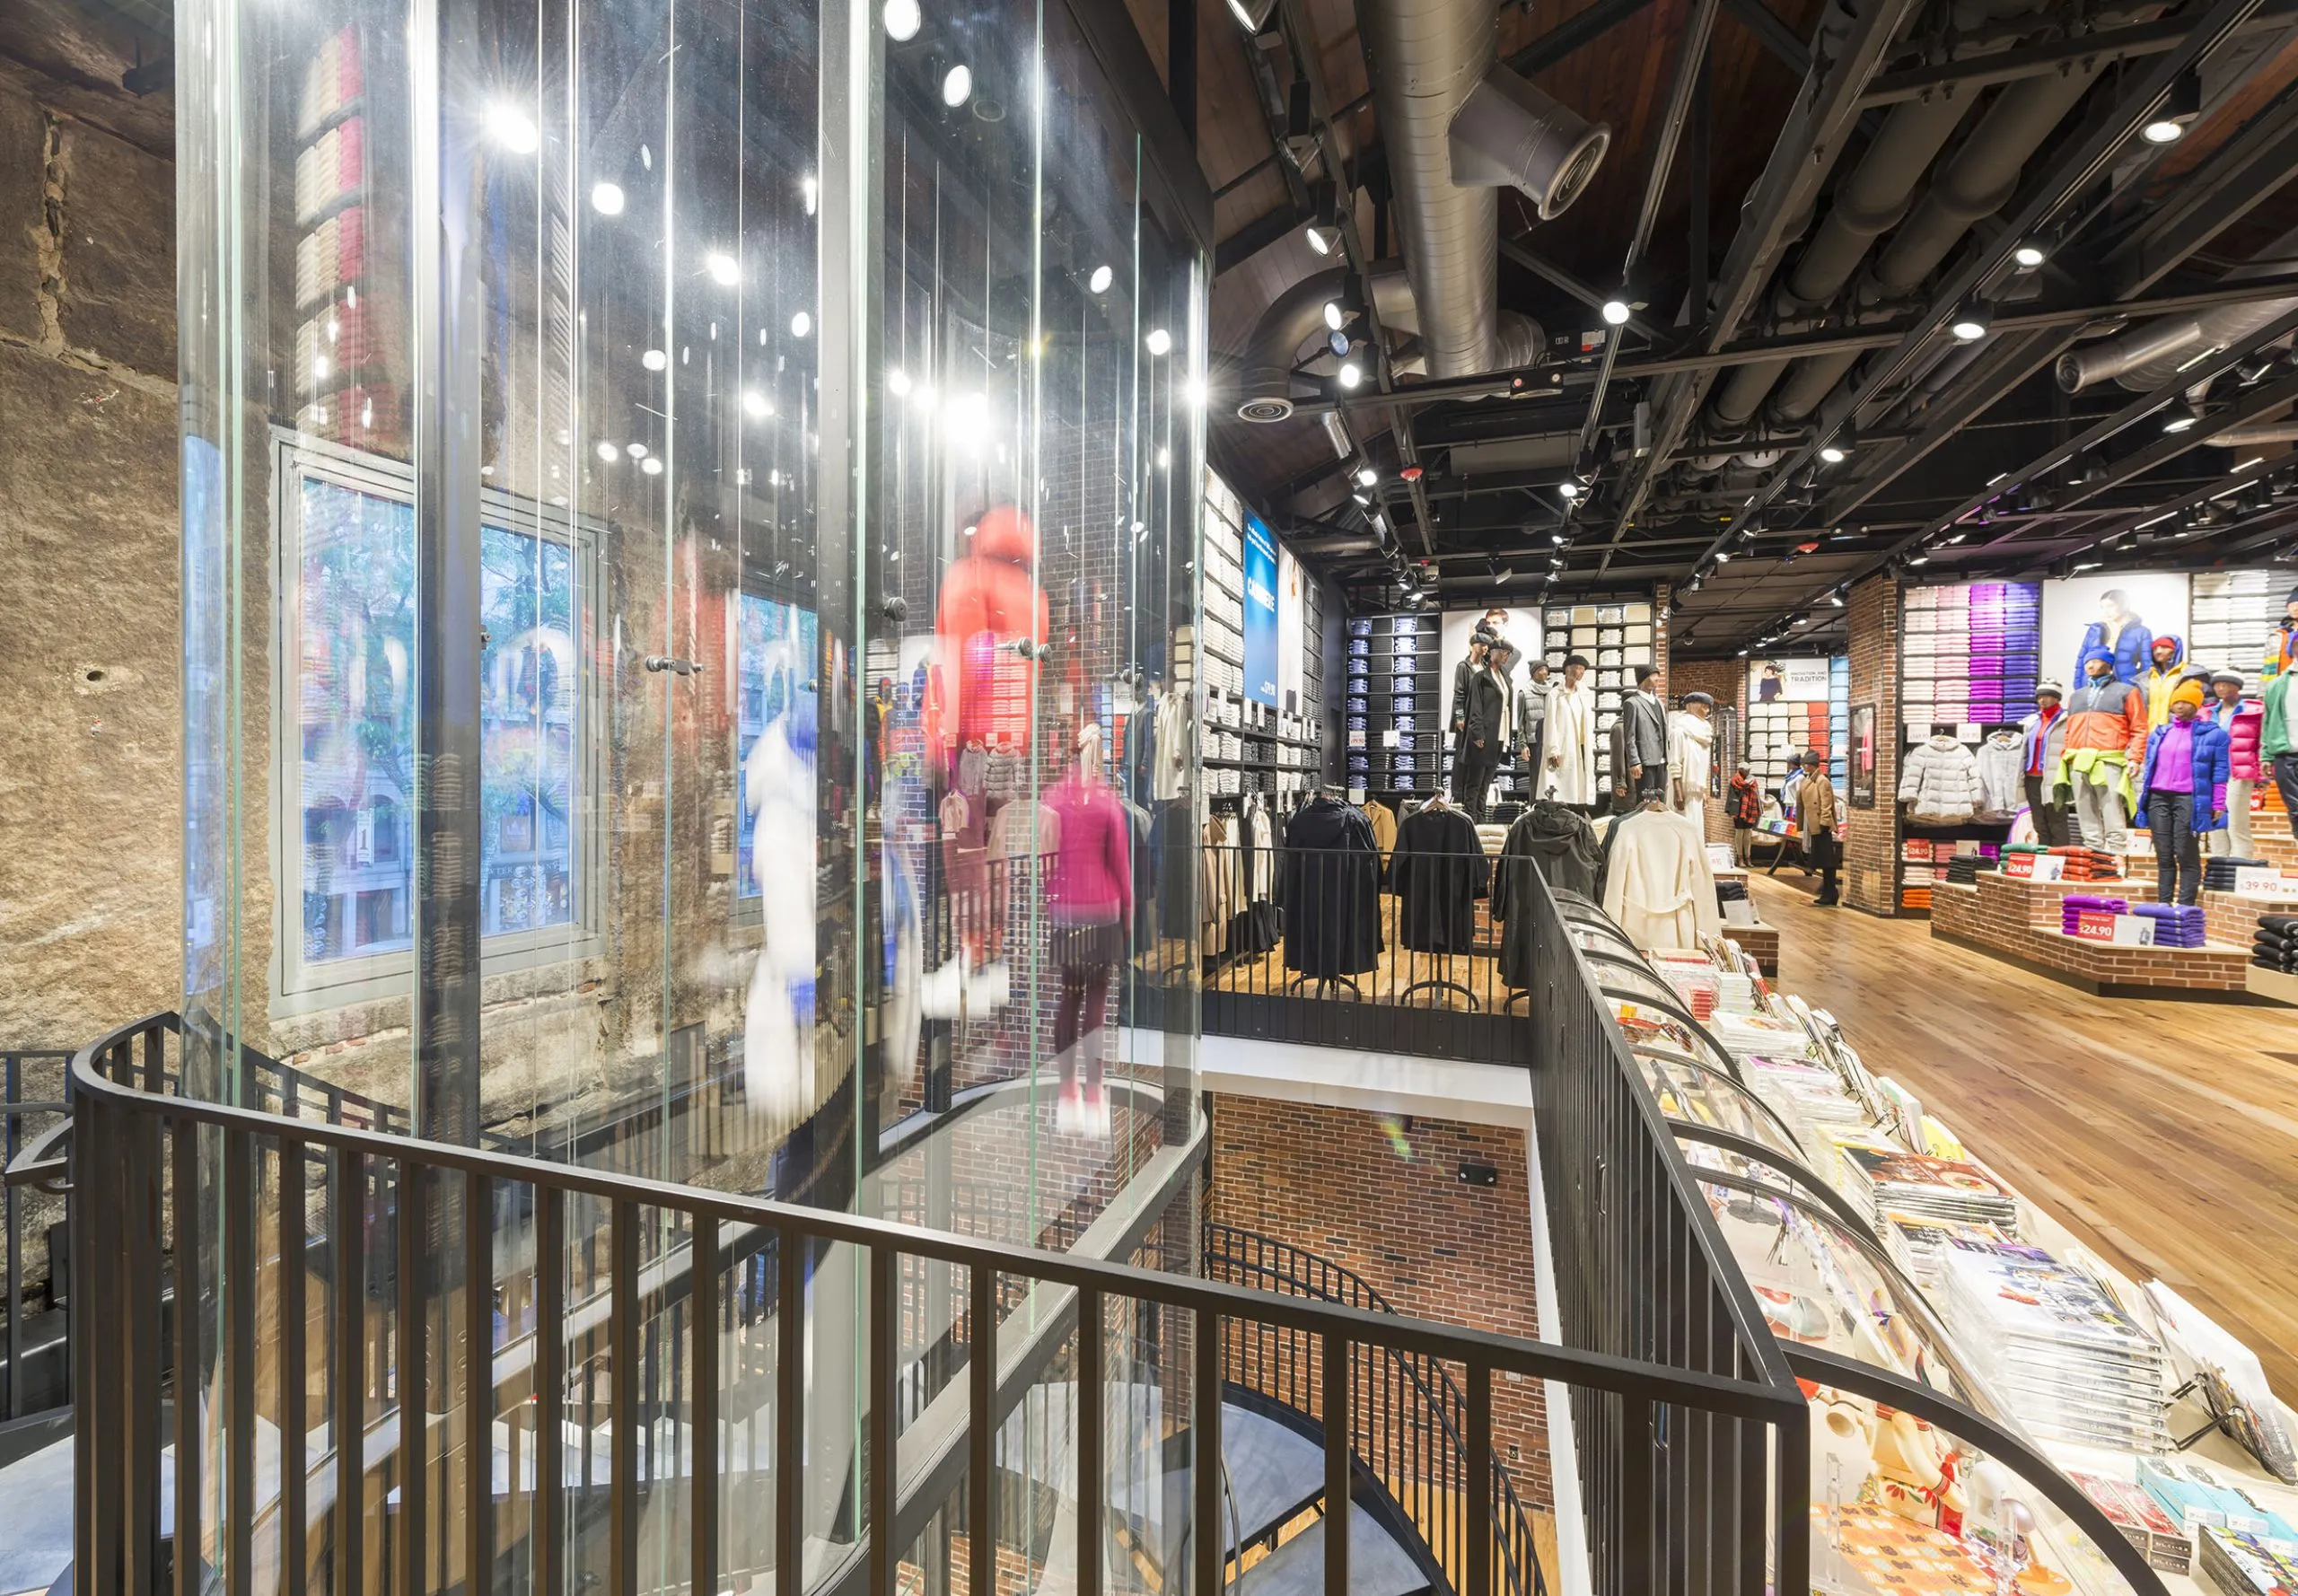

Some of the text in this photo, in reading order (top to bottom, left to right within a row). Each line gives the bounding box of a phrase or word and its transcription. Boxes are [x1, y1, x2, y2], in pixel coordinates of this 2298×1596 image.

[1791, 675, 1828, 683] TRADITION
[359, 829, 369, 851] 1
[2079, 924, 2113, 937] $24.90
